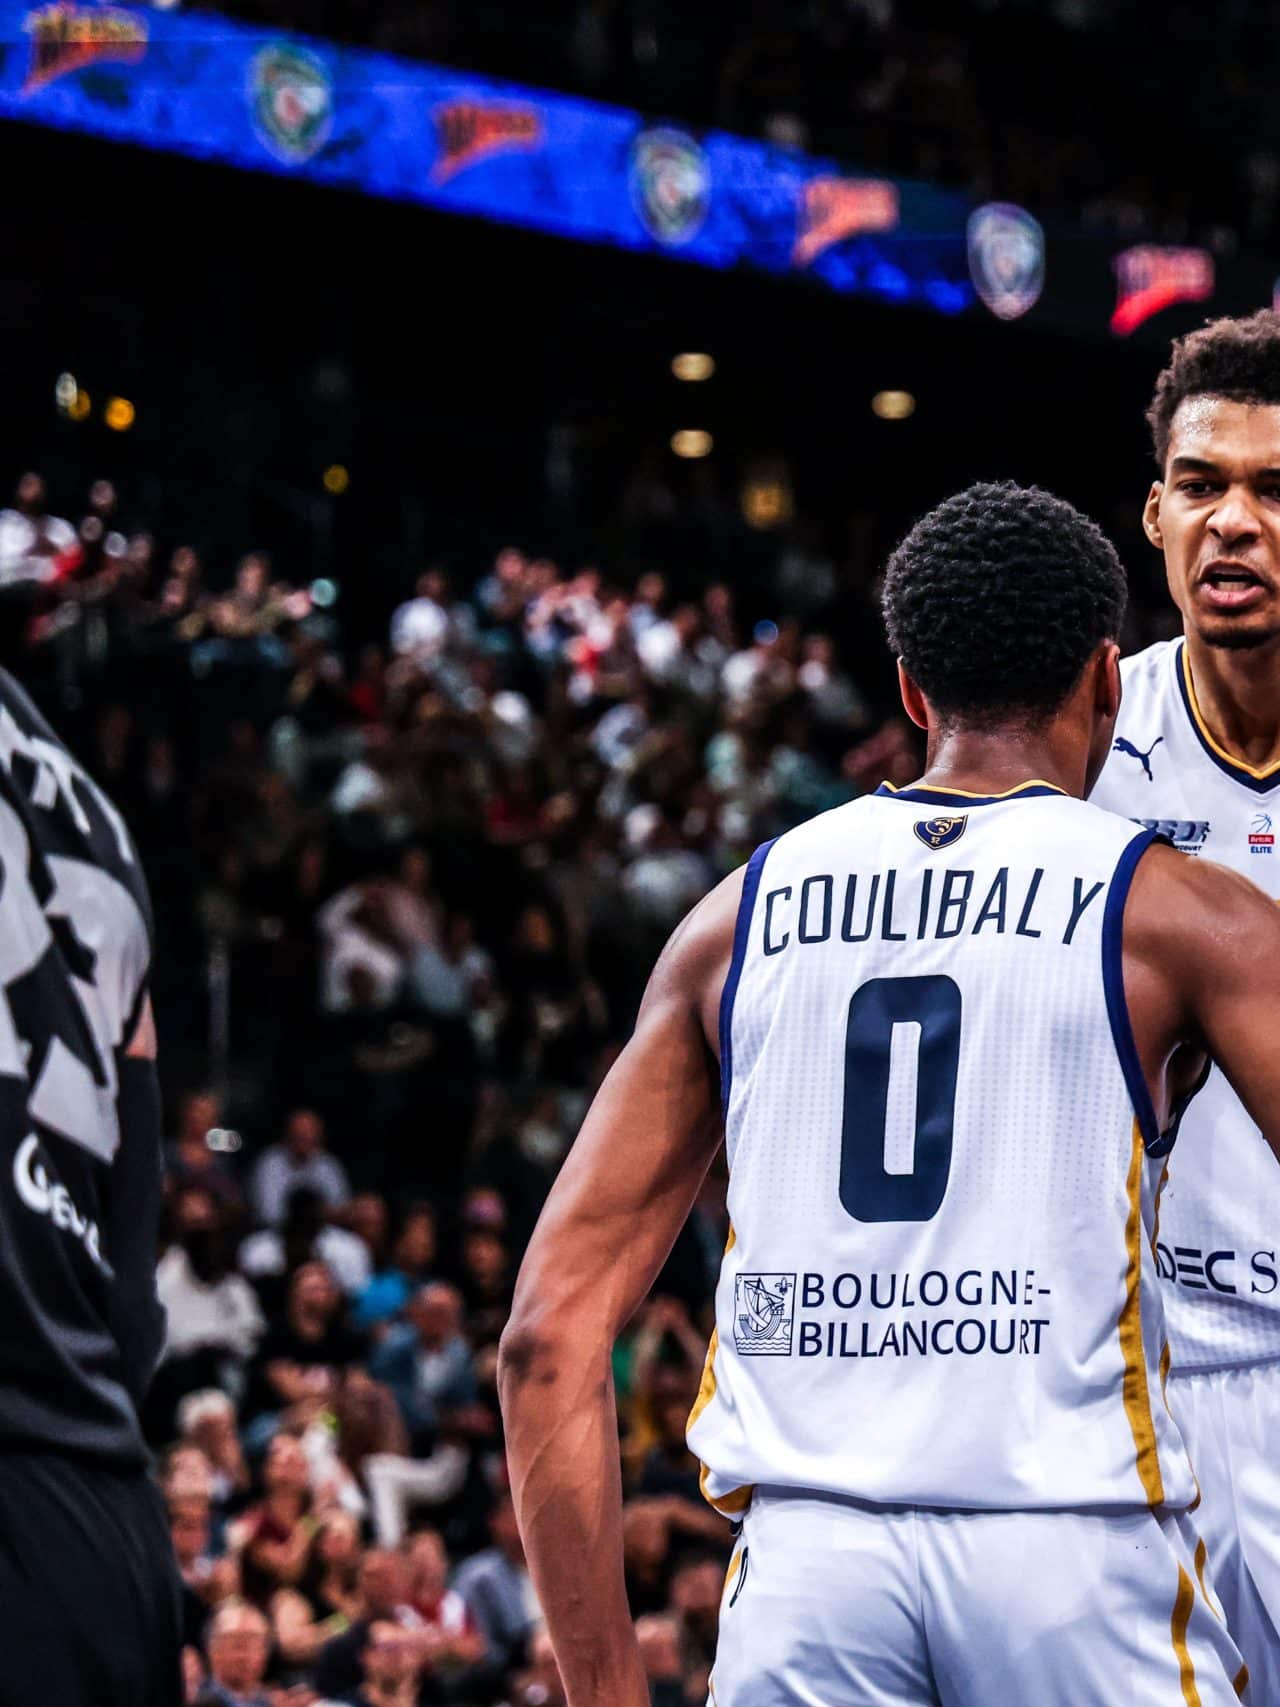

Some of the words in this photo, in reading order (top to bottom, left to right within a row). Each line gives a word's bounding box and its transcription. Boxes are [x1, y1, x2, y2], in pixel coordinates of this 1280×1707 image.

[763, 866, 1106, 957] COULIBALY
[838, 974, 963, 1224] 0
[801, 1269, 1051, 1310] BOULOGNE-
[798, 1318, 1051, 1358] BILLANCOURT
